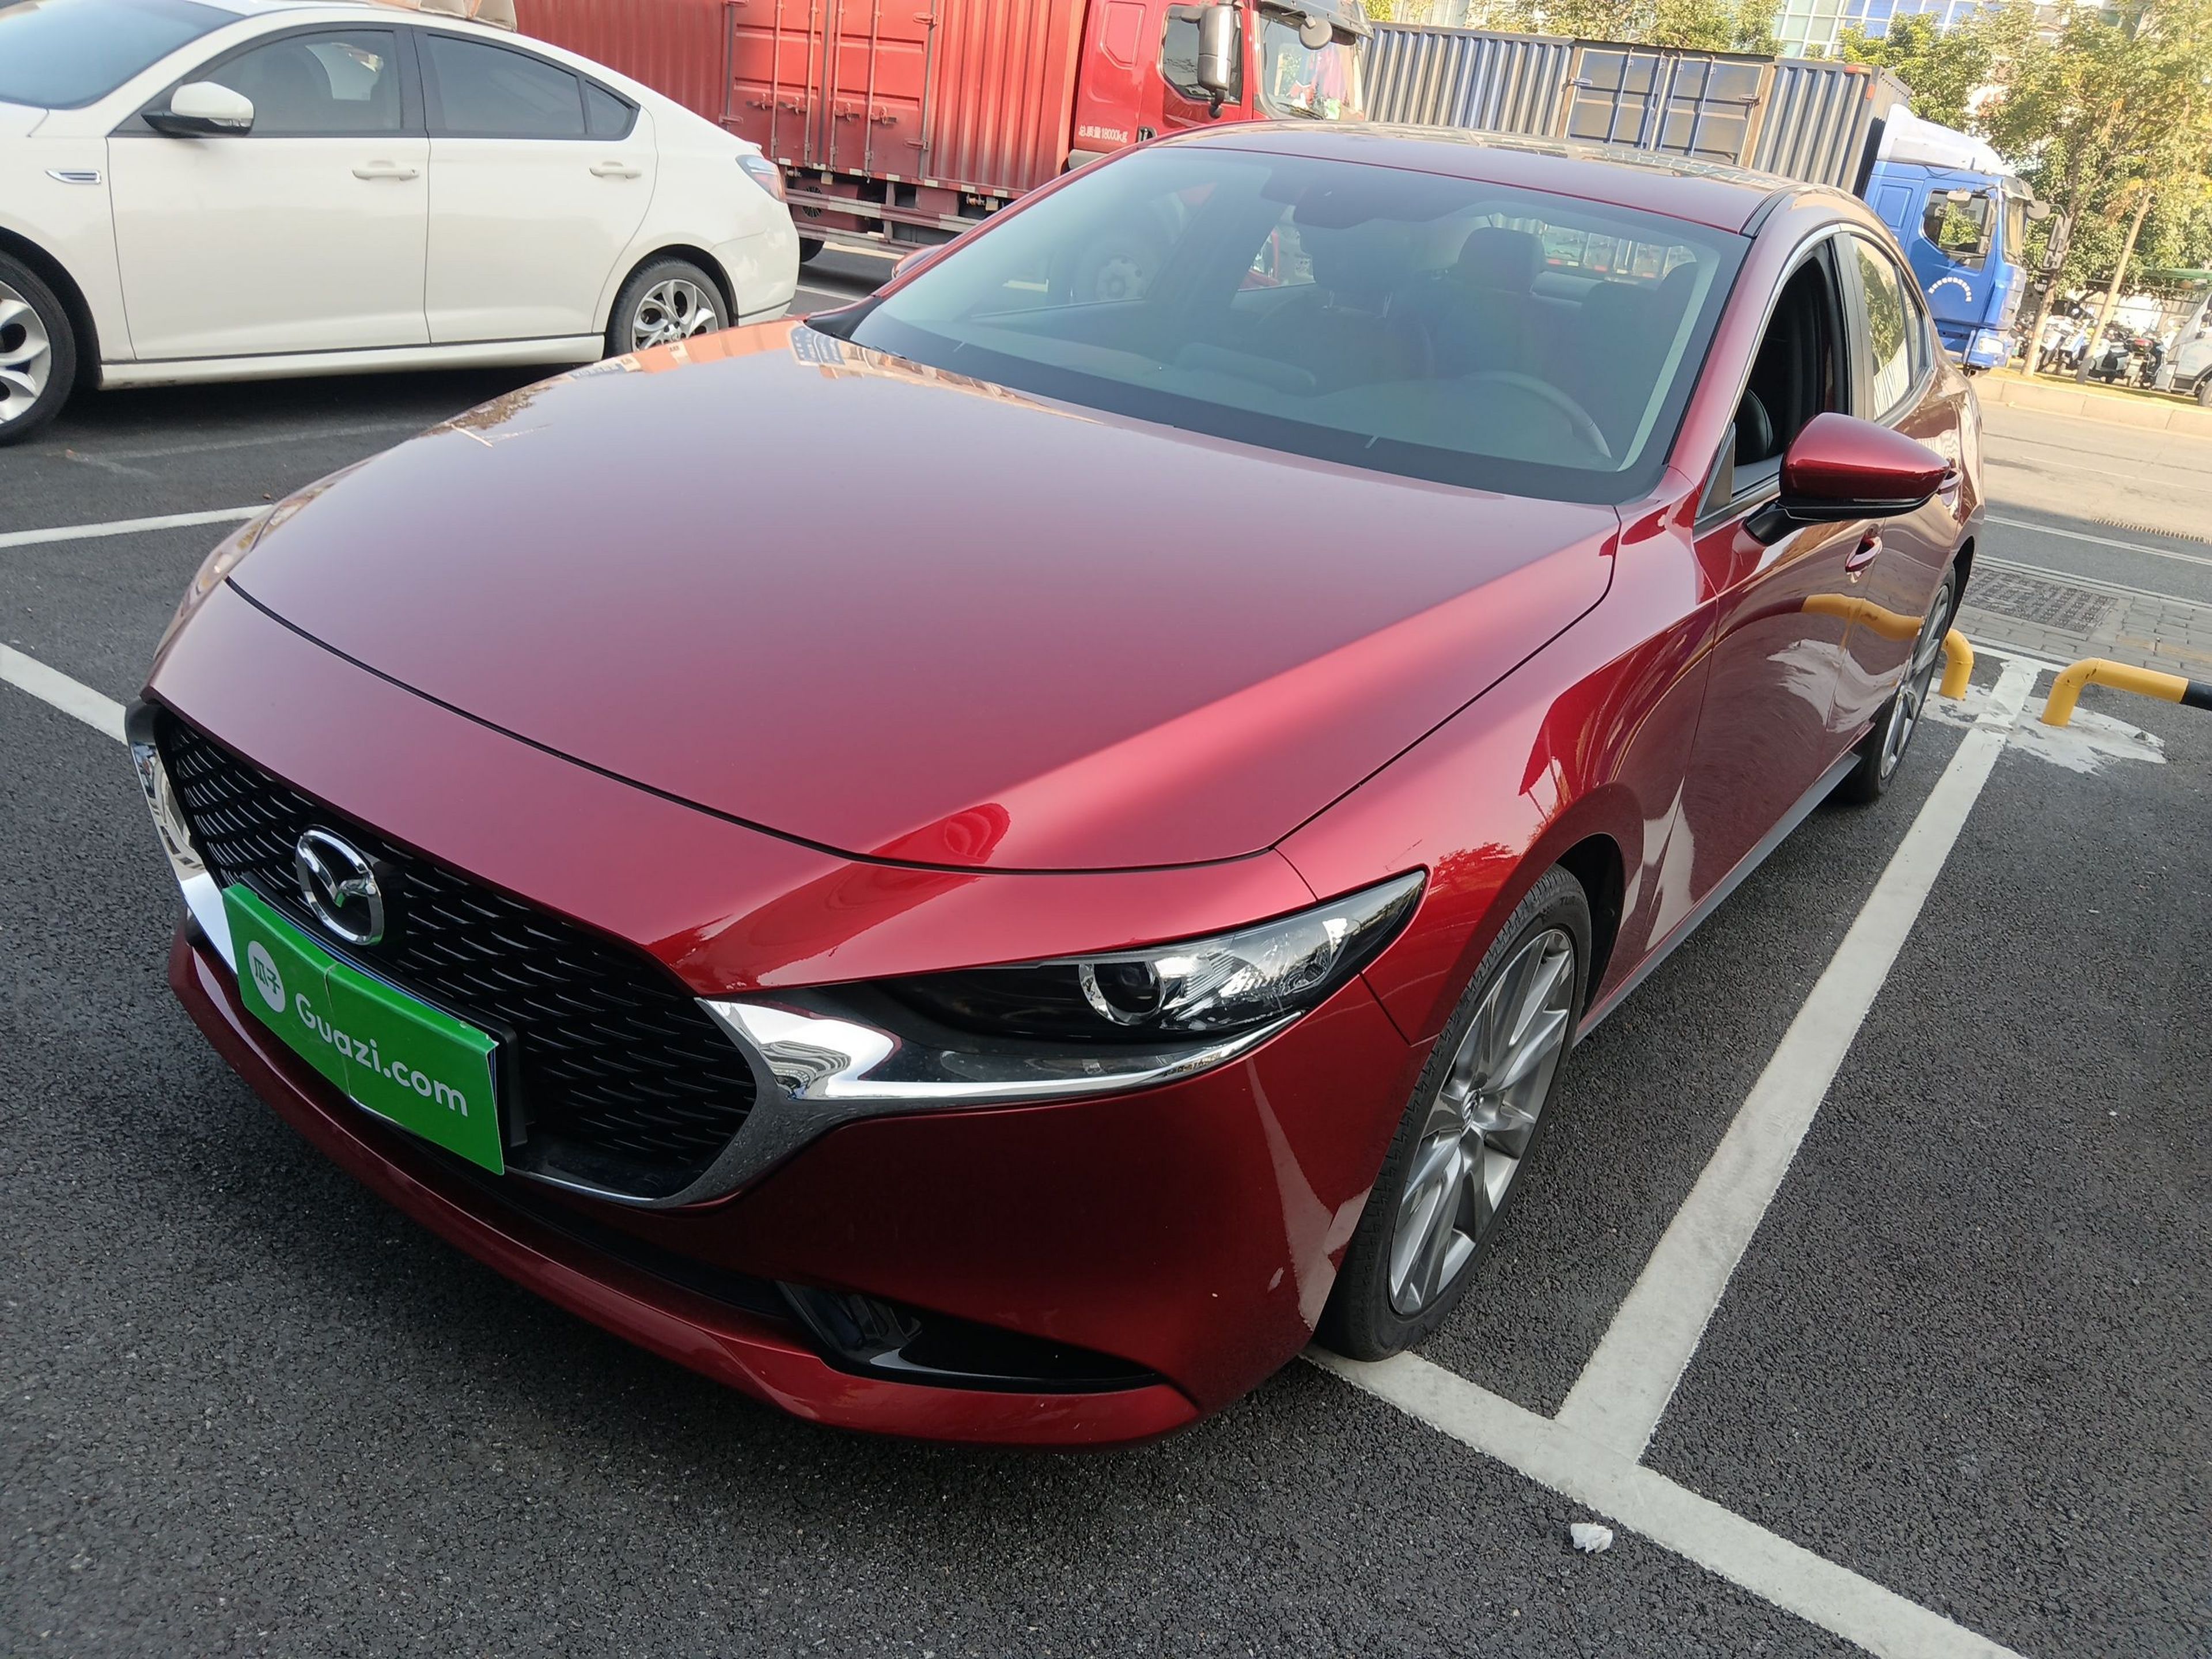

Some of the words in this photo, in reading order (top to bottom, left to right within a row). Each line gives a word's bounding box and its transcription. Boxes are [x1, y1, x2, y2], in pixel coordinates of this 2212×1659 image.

[1078, 124, 1128, 143] 总质量18000kg
[253, 956, 281, 994] 瓜子
[295, 993, 468, 1117] Guazi.com
